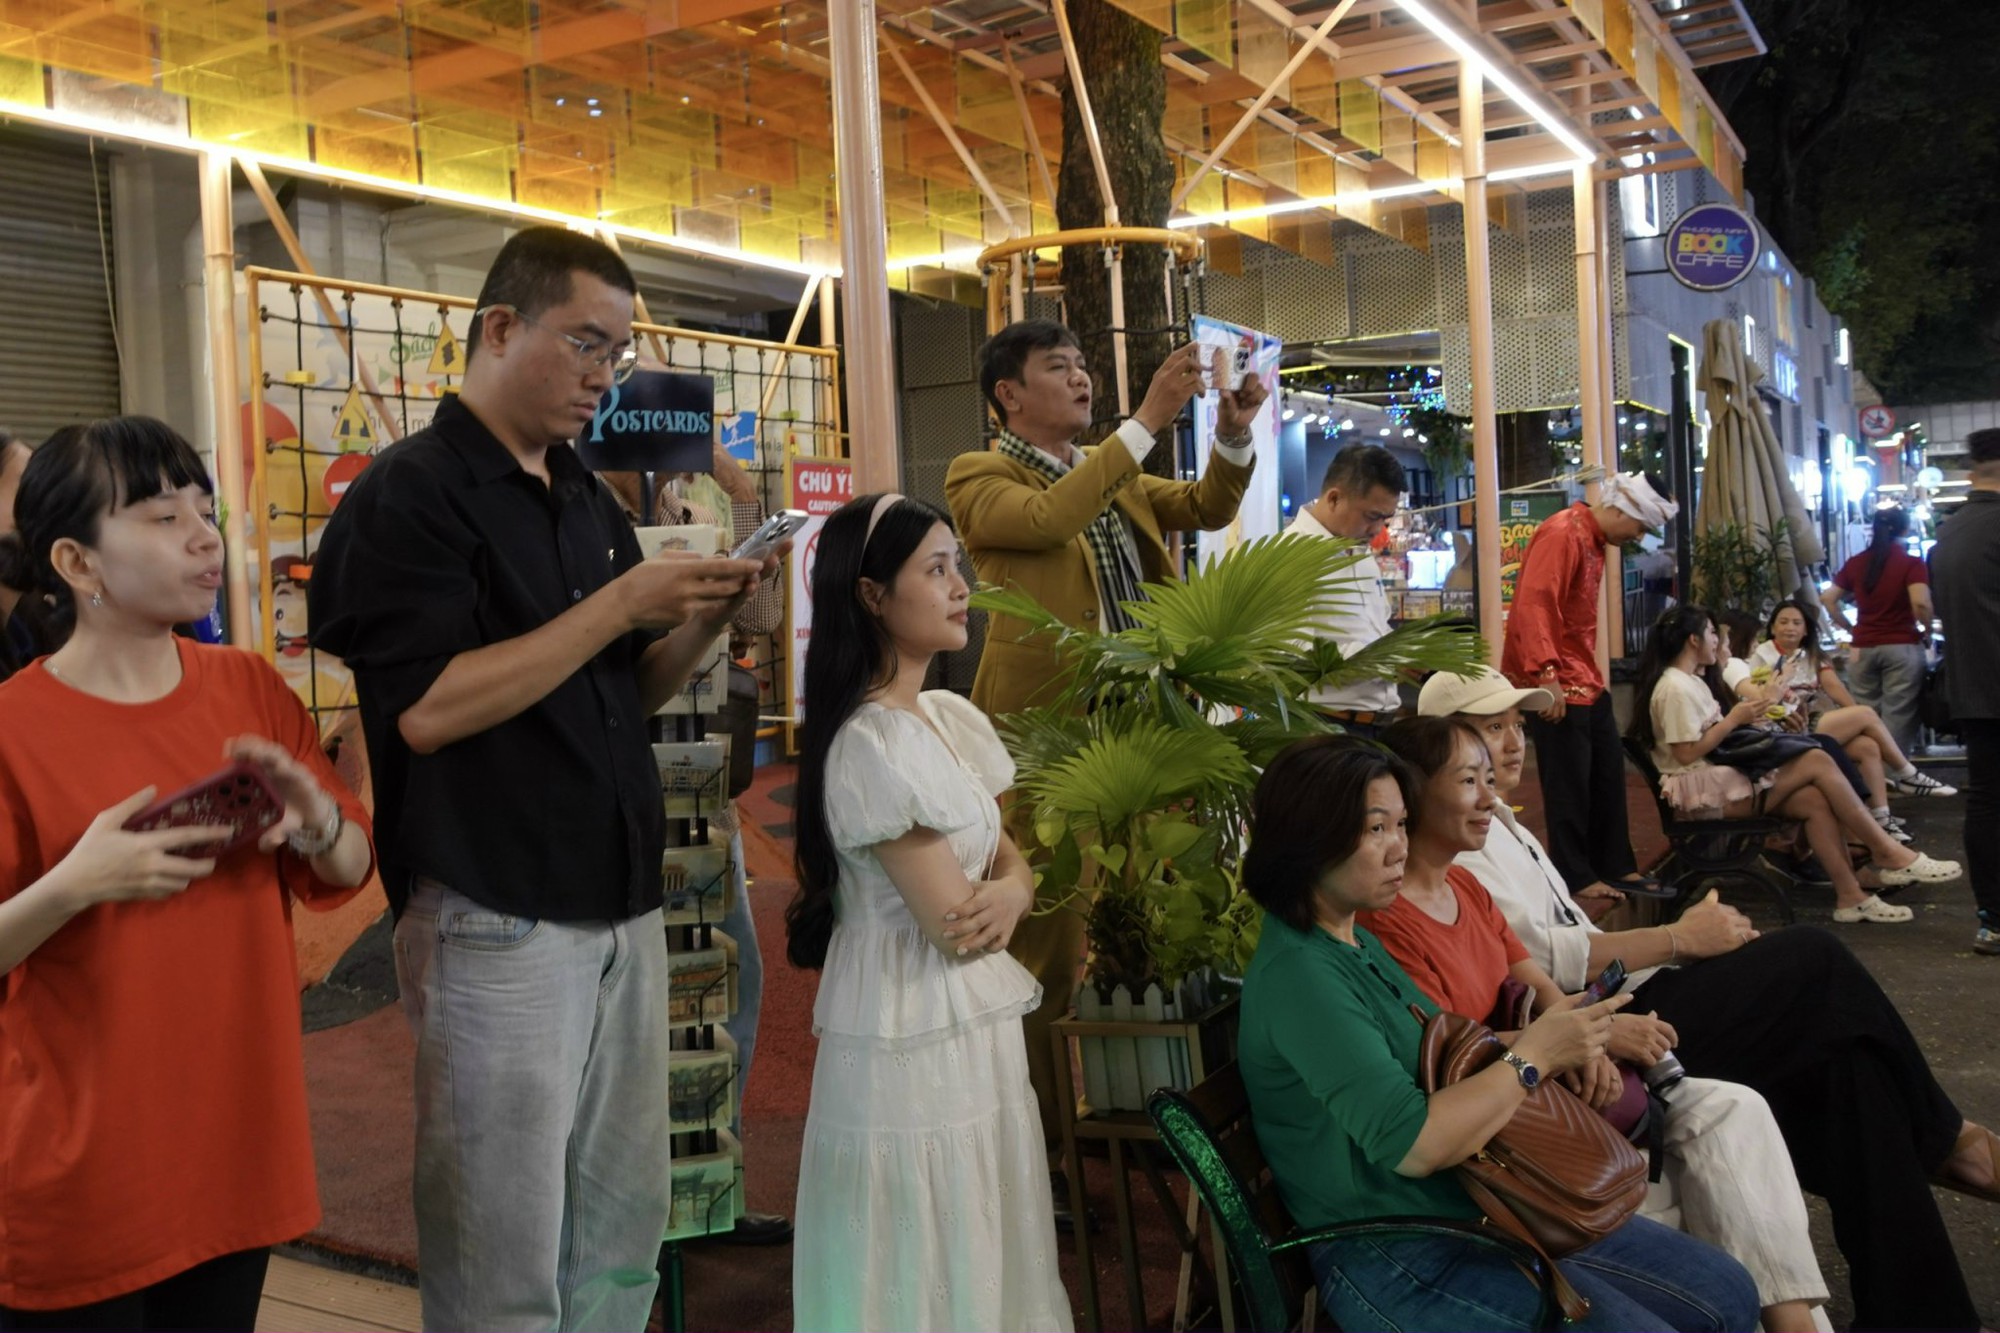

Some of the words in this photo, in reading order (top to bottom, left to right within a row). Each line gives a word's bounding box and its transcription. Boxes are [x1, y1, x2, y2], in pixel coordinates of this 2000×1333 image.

[1678, 233, 1745, 254] BOOK
[588, 383, 710, 443] POSTCARDS
[798, 468, 832, 494] CHÚ
